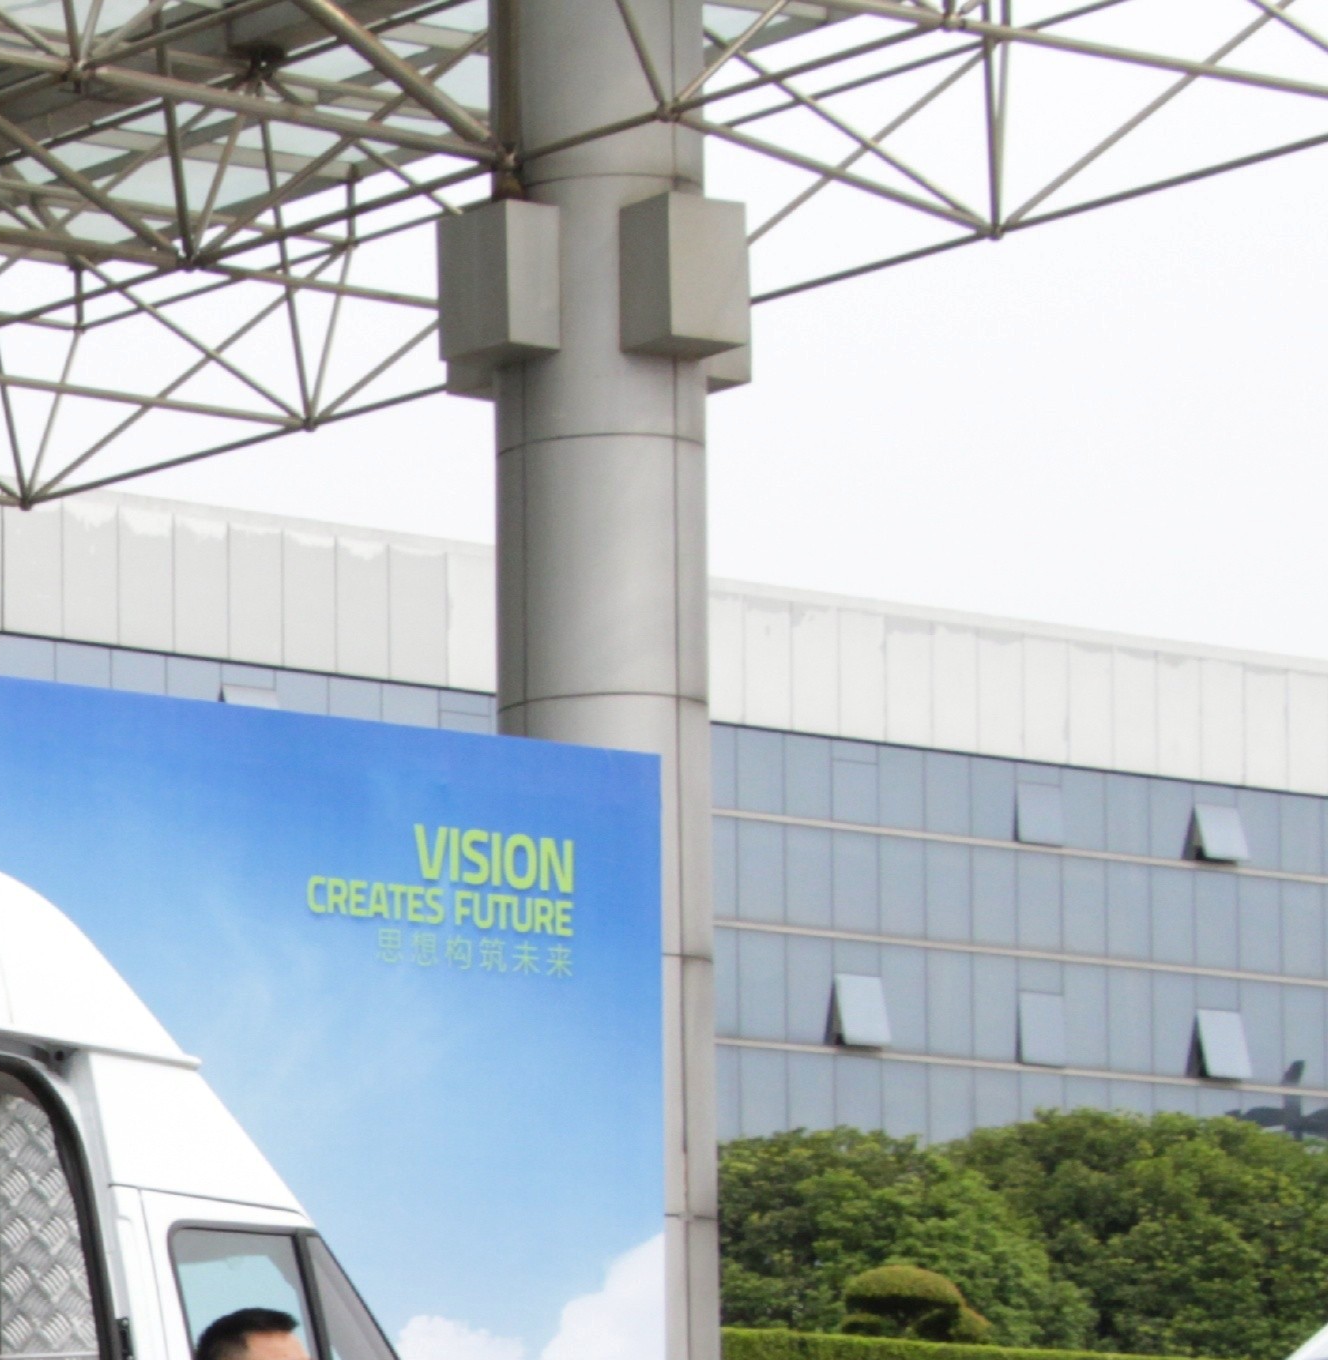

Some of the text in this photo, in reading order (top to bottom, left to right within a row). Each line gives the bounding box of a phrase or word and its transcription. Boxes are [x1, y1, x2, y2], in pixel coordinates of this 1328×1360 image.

[413, 823, 574, 894] VISION
[306, 875, 574, 937] CREATES FUTURE
[376, 928, 574, 977] 思想构筑未来
